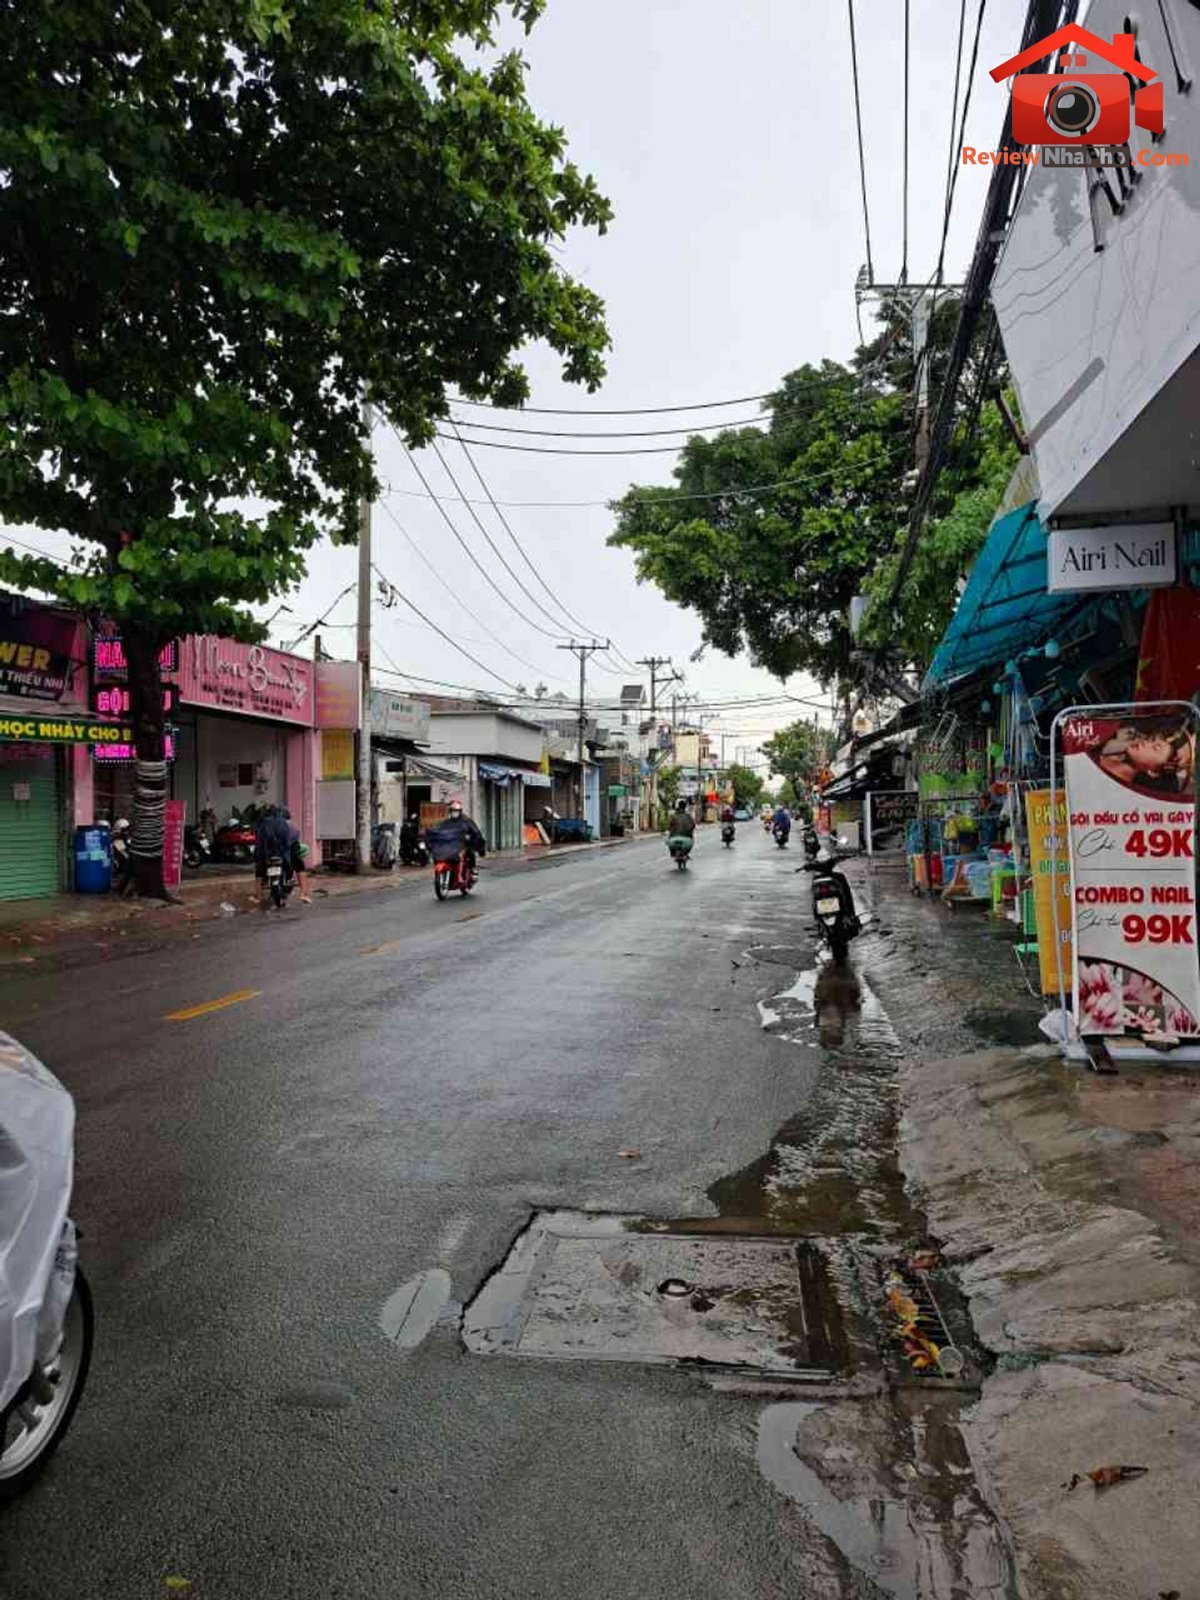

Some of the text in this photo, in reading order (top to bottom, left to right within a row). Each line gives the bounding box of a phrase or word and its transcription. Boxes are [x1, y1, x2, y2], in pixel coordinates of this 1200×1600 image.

[1061, 540, 1165, 573] Airi Nail
[0, 720, 35, 738] HỌC
[88, 727, 119, 740] CHO
[1065, 721, 1094, 737] Airi
[1125, 829, 1193, 858] 49K
[1075, 886, 1144, 904] COMBO
[1151, 886, 1194, 904] NAIL
[1122, 914, 1194, 944] 99K
